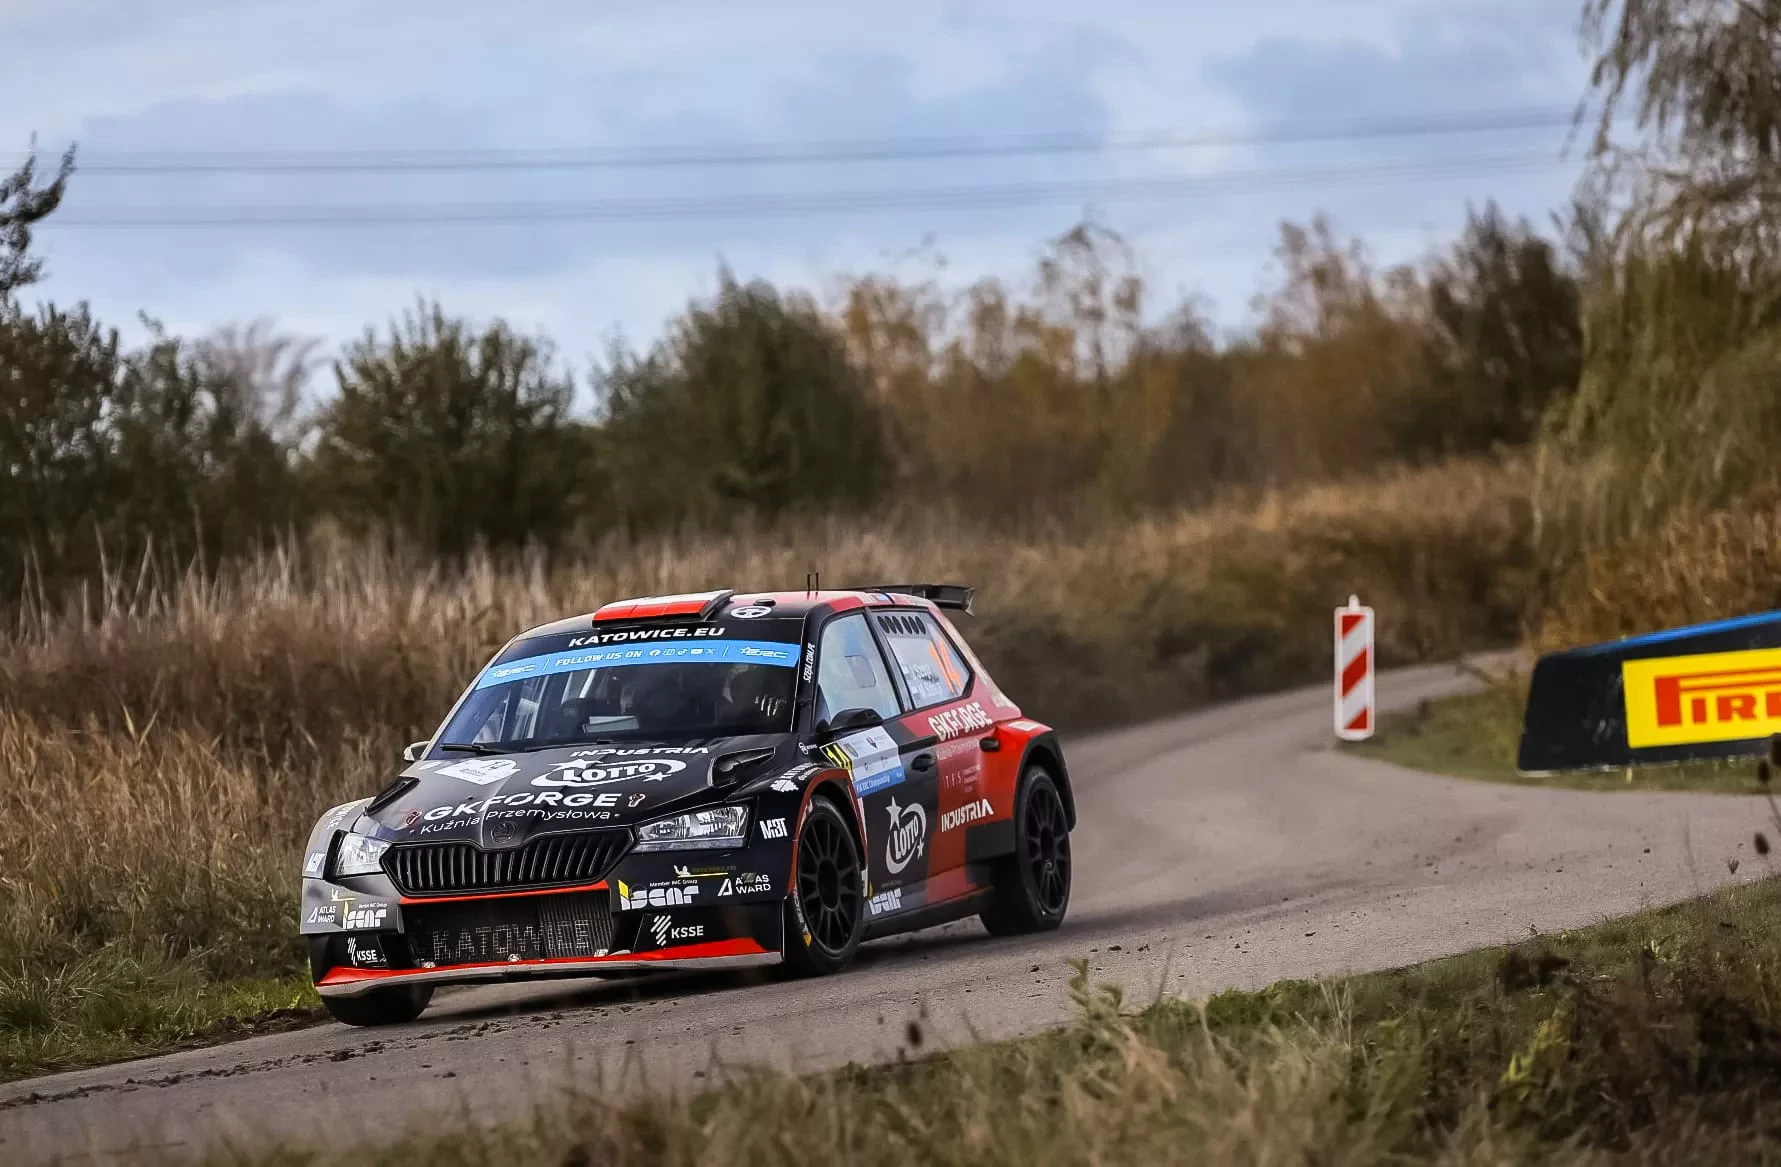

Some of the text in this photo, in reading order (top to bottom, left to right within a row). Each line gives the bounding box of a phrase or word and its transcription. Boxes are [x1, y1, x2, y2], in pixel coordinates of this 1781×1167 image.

[568, 627, 725, 647] KATOWICE.EU
[555, 656, 603, 667] FOLLOW
[605, 652, 622, 660] US
[625, 650, 642, 658] ON
[569, 747, 709, 757] INDUSTRIA
[562, 763, 656, 782] LOTTO
[423, 793, 622, 822] GKFORGE
[941, 799, 994, 833] INDUSTRIA
[894, 815, 919, 860] LOTTO
[735, 875, 769, 886] AAS
[735, 883, 771, 895] WARD
[433, 919, 589, 960] KATOWICE
[671, 925, 704, 939] KSSE
[356, 949, 377, 961] KSSE
